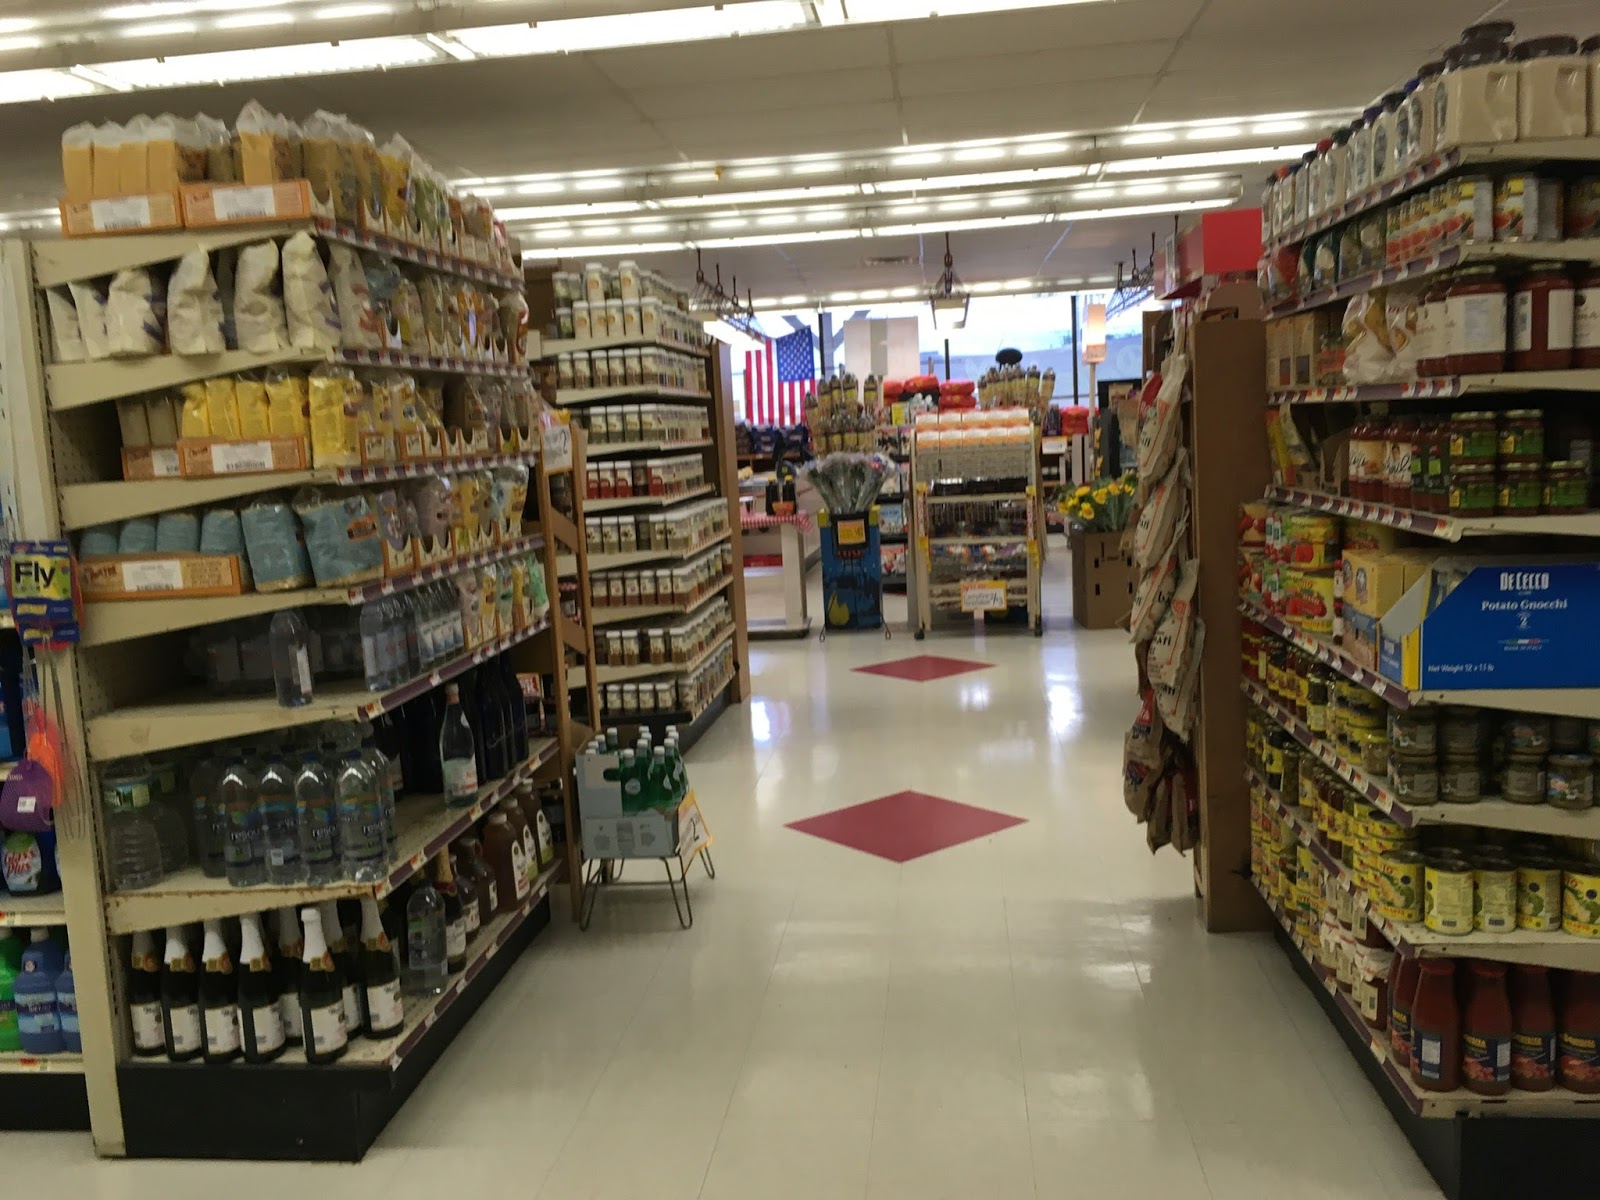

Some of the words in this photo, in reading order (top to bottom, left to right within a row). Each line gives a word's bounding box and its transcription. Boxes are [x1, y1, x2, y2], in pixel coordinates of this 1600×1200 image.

[15, 562, 55, 589] Fly
[1481, 600, 1518, 612] Potato
[1520, 598, 1568, 611] Gnocchi
[1519, 616, 1529, 628] 2
[1428, 664, 1440, 672] Net
[1441, 664, 1463, 673] Weight
[1465, 663, 1472, 672] 12
[6, 862, 31, 878] Plus
